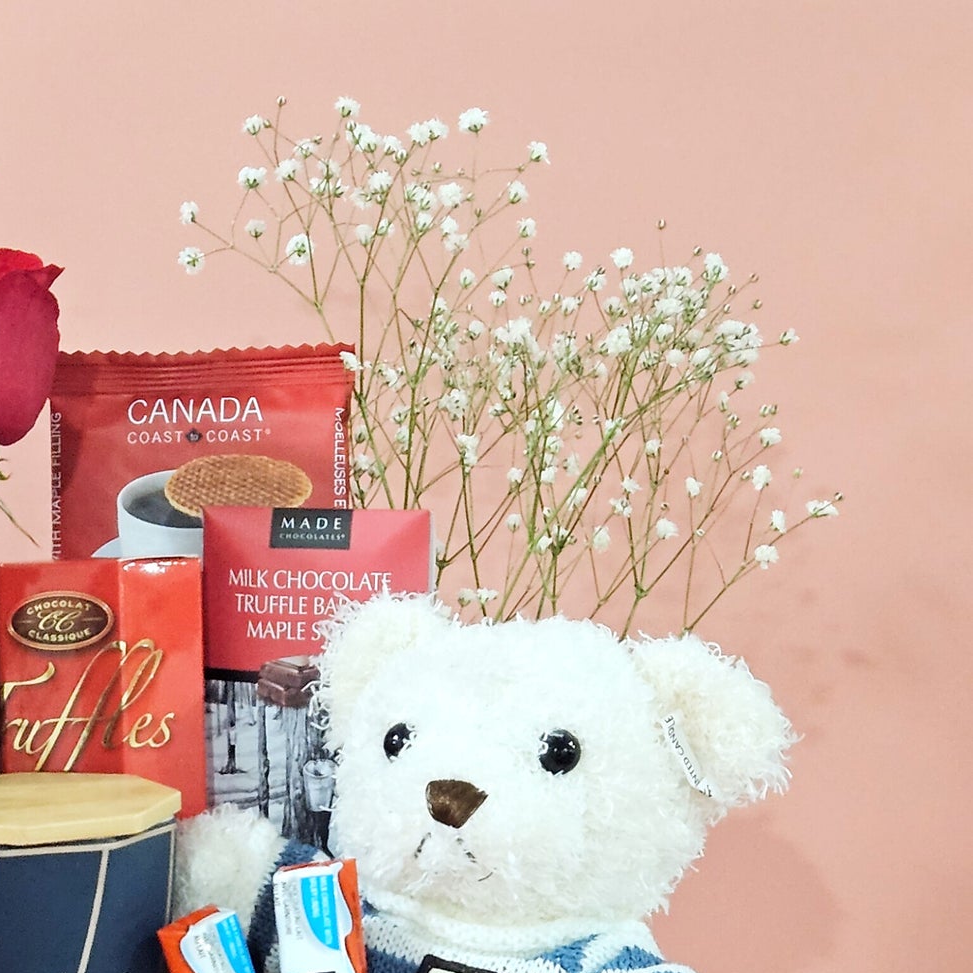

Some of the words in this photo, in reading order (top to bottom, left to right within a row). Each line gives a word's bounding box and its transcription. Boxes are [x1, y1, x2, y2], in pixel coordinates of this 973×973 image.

[127, 396, 264, 425] CANADA
[51, 412, 63, 466] FILLING
[127, 431, 183, 445] COAST
[206, 429, 262, 443] COAST
[334, 407, 347, 496] MOELLEUSES
[51, 471, 62, 525] MAPLE
[334, 499, 347, 510] E
[280, 517, 342, 530] MADE
[228, 569, 269, 589] MILK
[273, 569, 392, 591] CHOCOLATE
[26, 600, 92, 616] CHOCOLAT
[235, 593, 308, 616] TRUFFLE
[28, 627, 92, 642] CLASSIQUE
[246, 620, 306, 641] MAPLE
